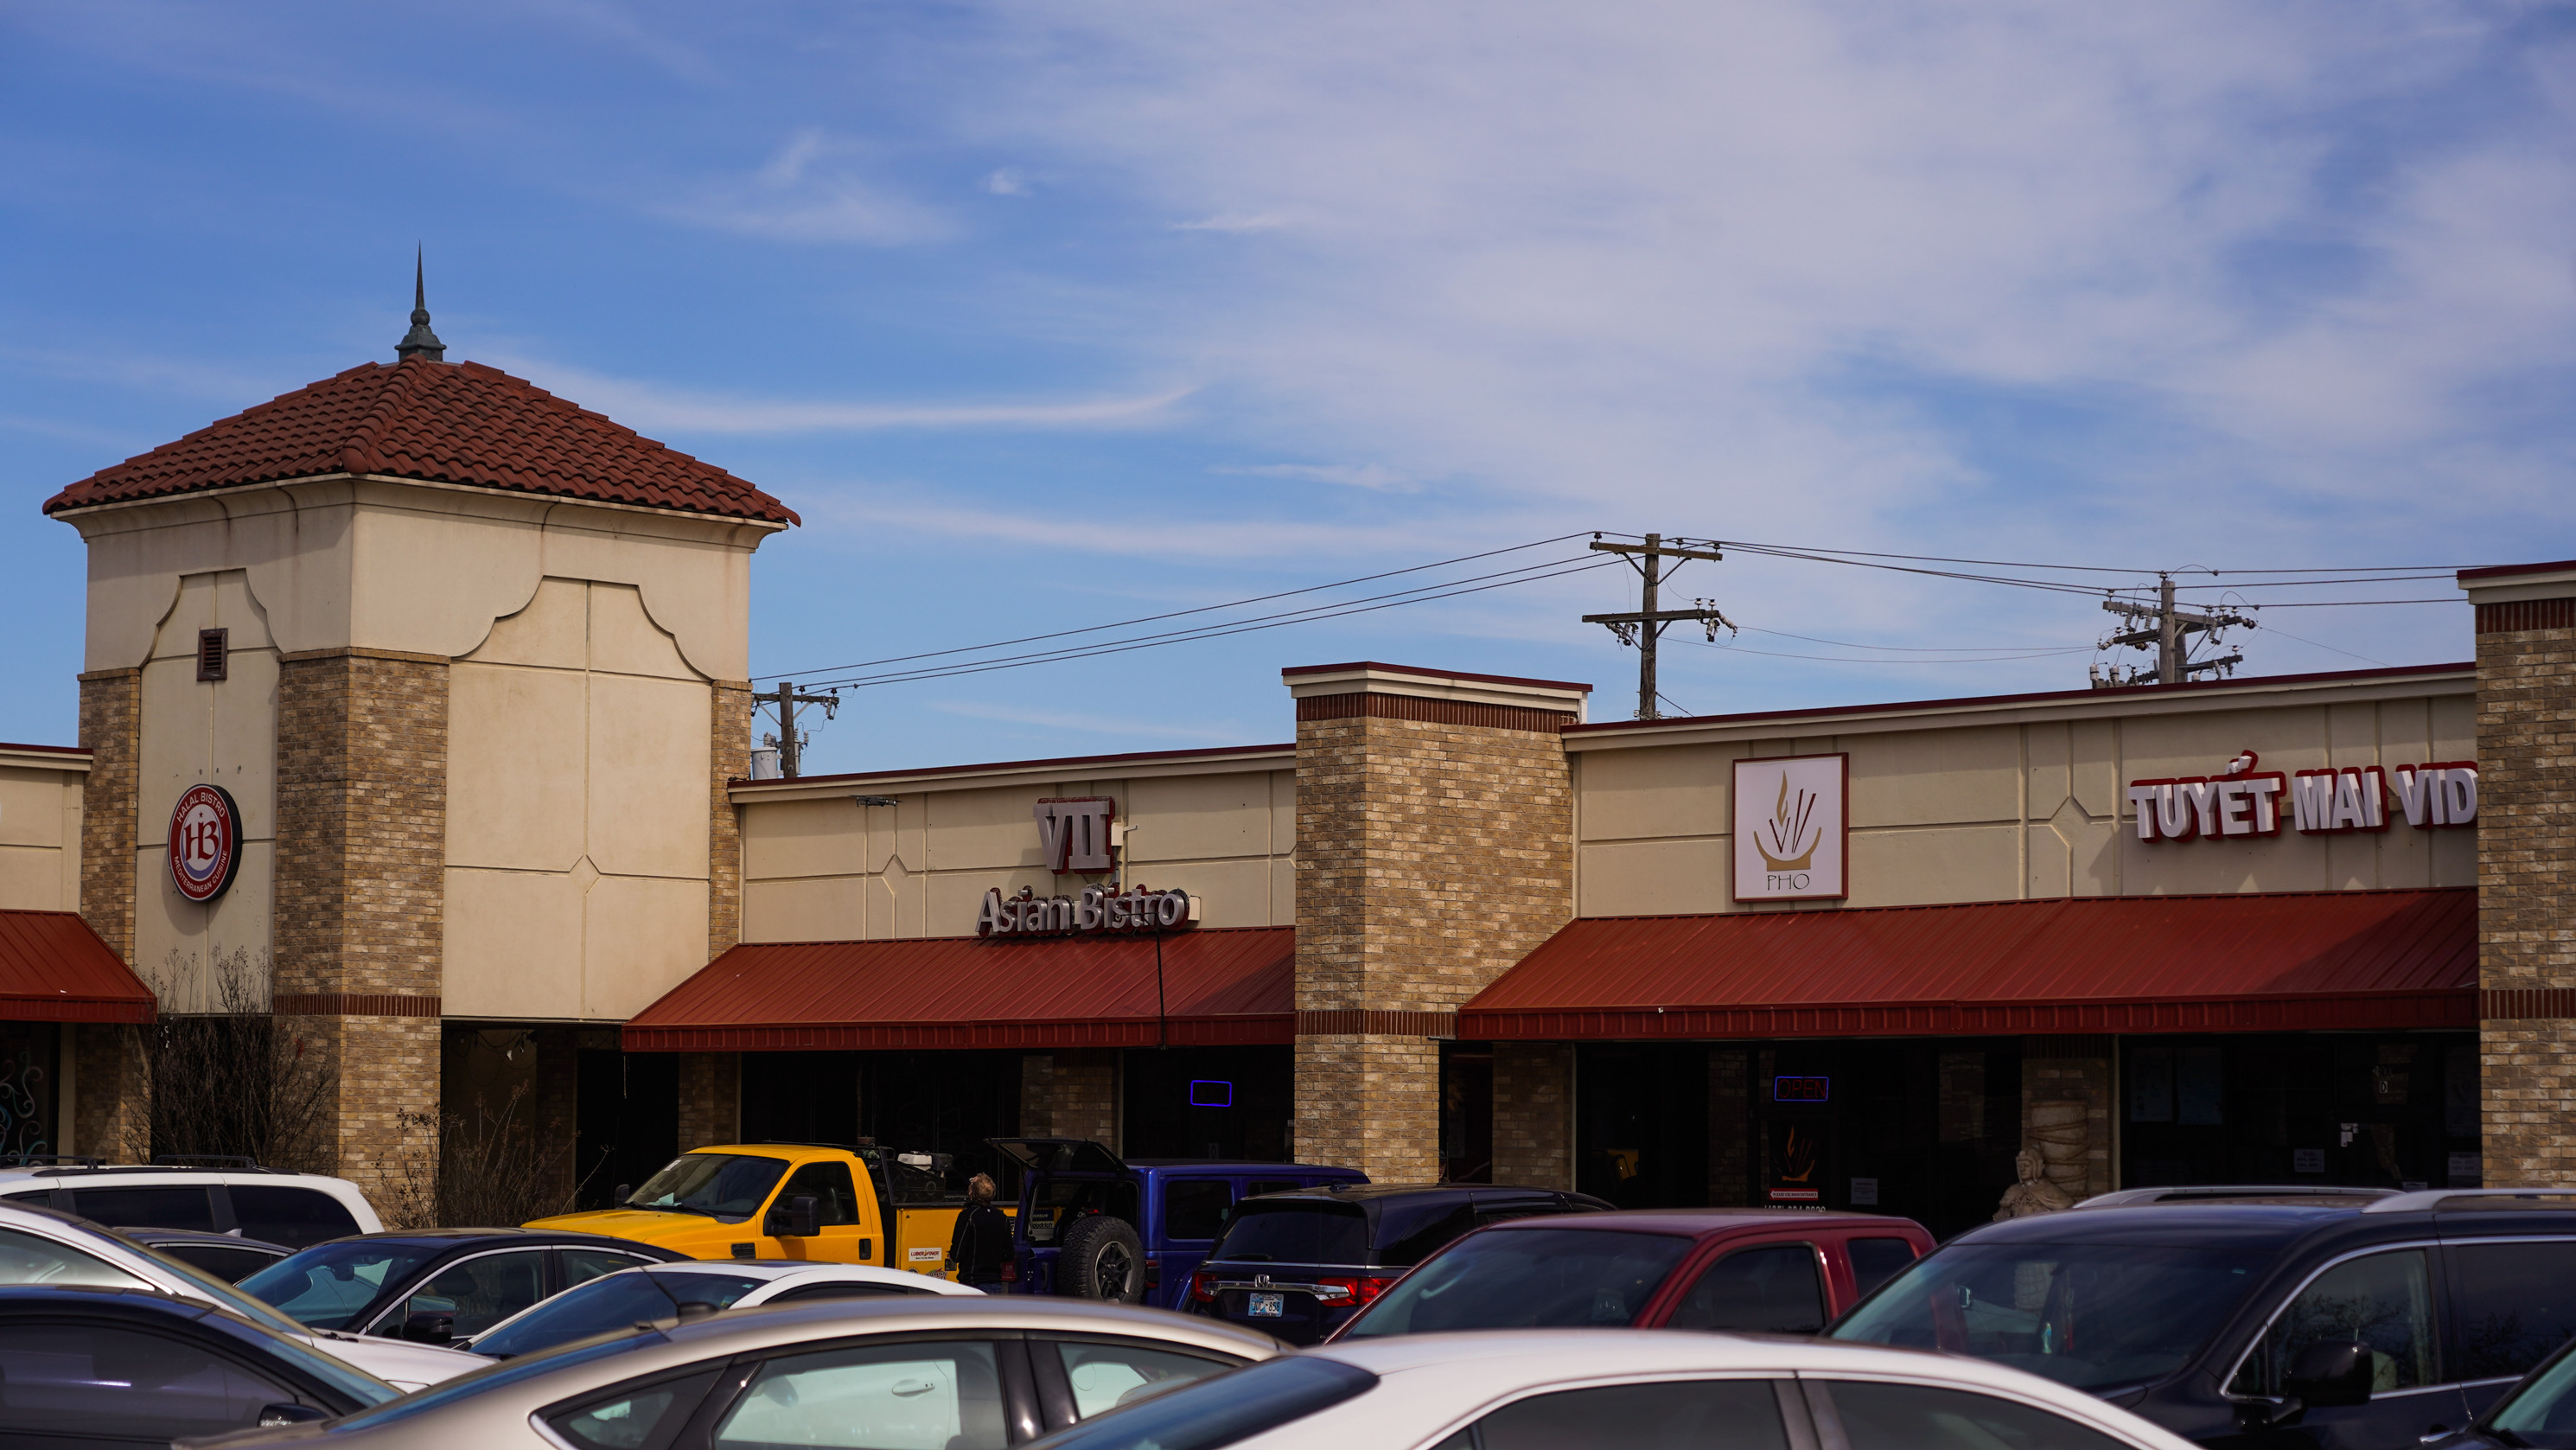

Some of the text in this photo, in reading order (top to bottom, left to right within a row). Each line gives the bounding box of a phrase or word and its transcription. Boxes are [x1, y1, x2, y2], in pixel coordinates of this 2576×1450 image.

[176, 792, 226, 822] HALAL BISTRO
[2291, 770, 2384, 832] MAI
[2394, 766, 2477, 827] VID
[183, 821, 220, 861] HB
[1033, 799, 1113, 872] VII
[174, 850, 228, 893] MEDITERRANEAN CUISINE
[1767, 873, 1810, 891] PHO
[975, 885, 1186, 936] Asian Bistro
[1777, 1079, 1827, 1100] OPEN
